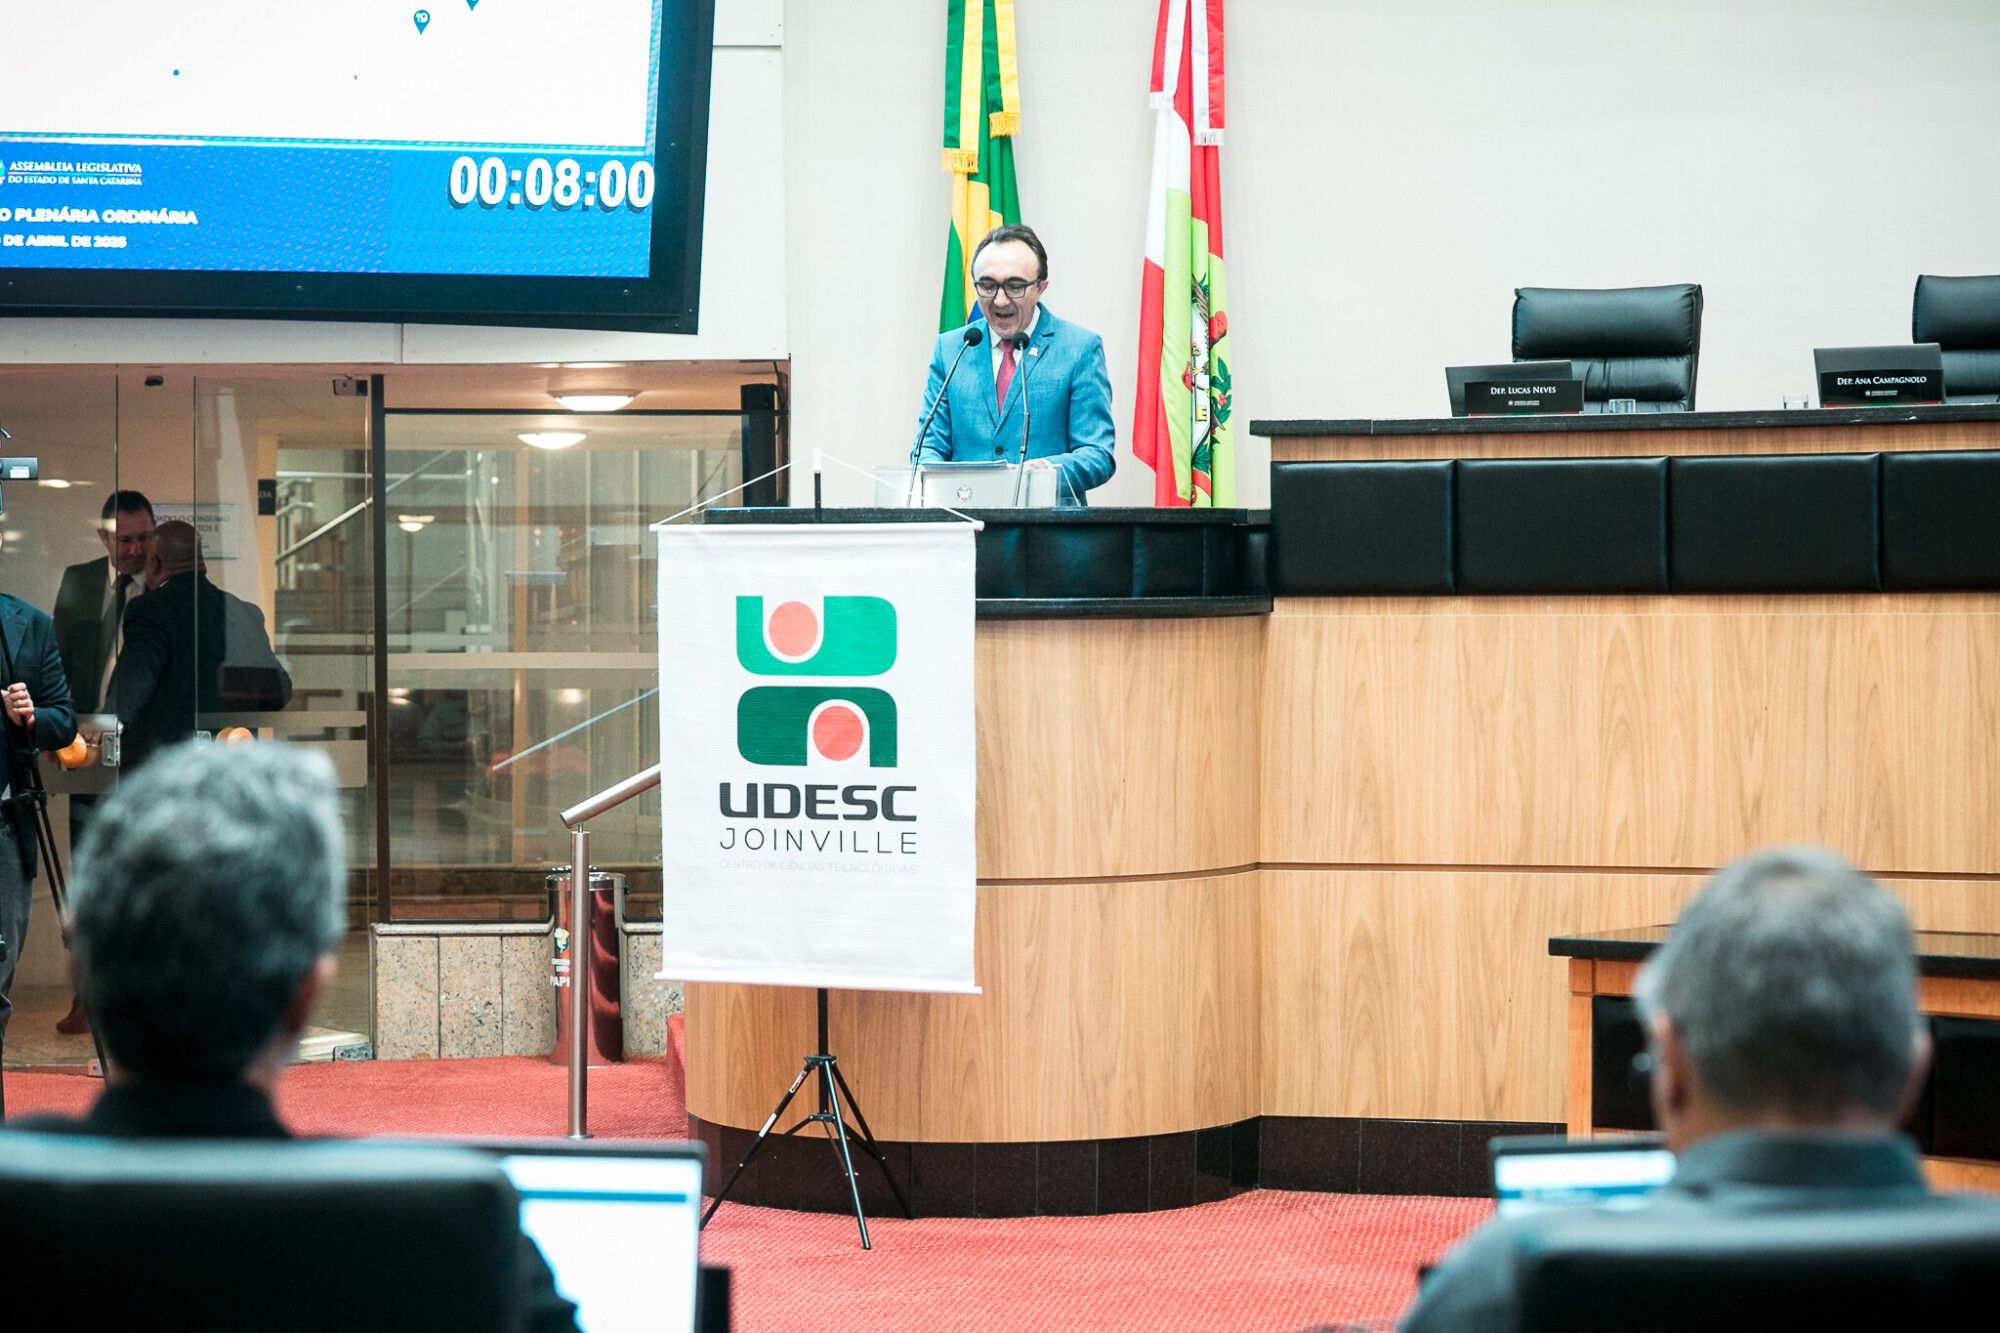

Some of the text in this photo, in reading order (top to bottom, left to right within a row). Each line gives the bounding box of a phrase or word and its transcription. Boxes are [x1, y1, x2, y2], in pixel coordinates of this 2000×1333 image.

[9, 161, 143, 174] ASSEMBLEIA LEGISLATIVA
[7, 175, 143, 186] DO ESTADO DE SANTA CATARINA
[449, 155, 655, 210] 00:08:00
[14, 205, 100, 223] PLENÁRIA
[102, 207, 199, 225] ORDINÁRIA
[3, 234, 25, 247] DE
[25, 234, 70, 248] ABRIL
[71, 235, 92, 248] DE
[719, 782, 918, 822] UDESC
[719, 827, 918, 855] JOINVILLE
[719, 858, 762, 870] CENTRO
[763, 859, 778, 871] DE
[828, 861, 918, 875] TECNOLÓGICAS
